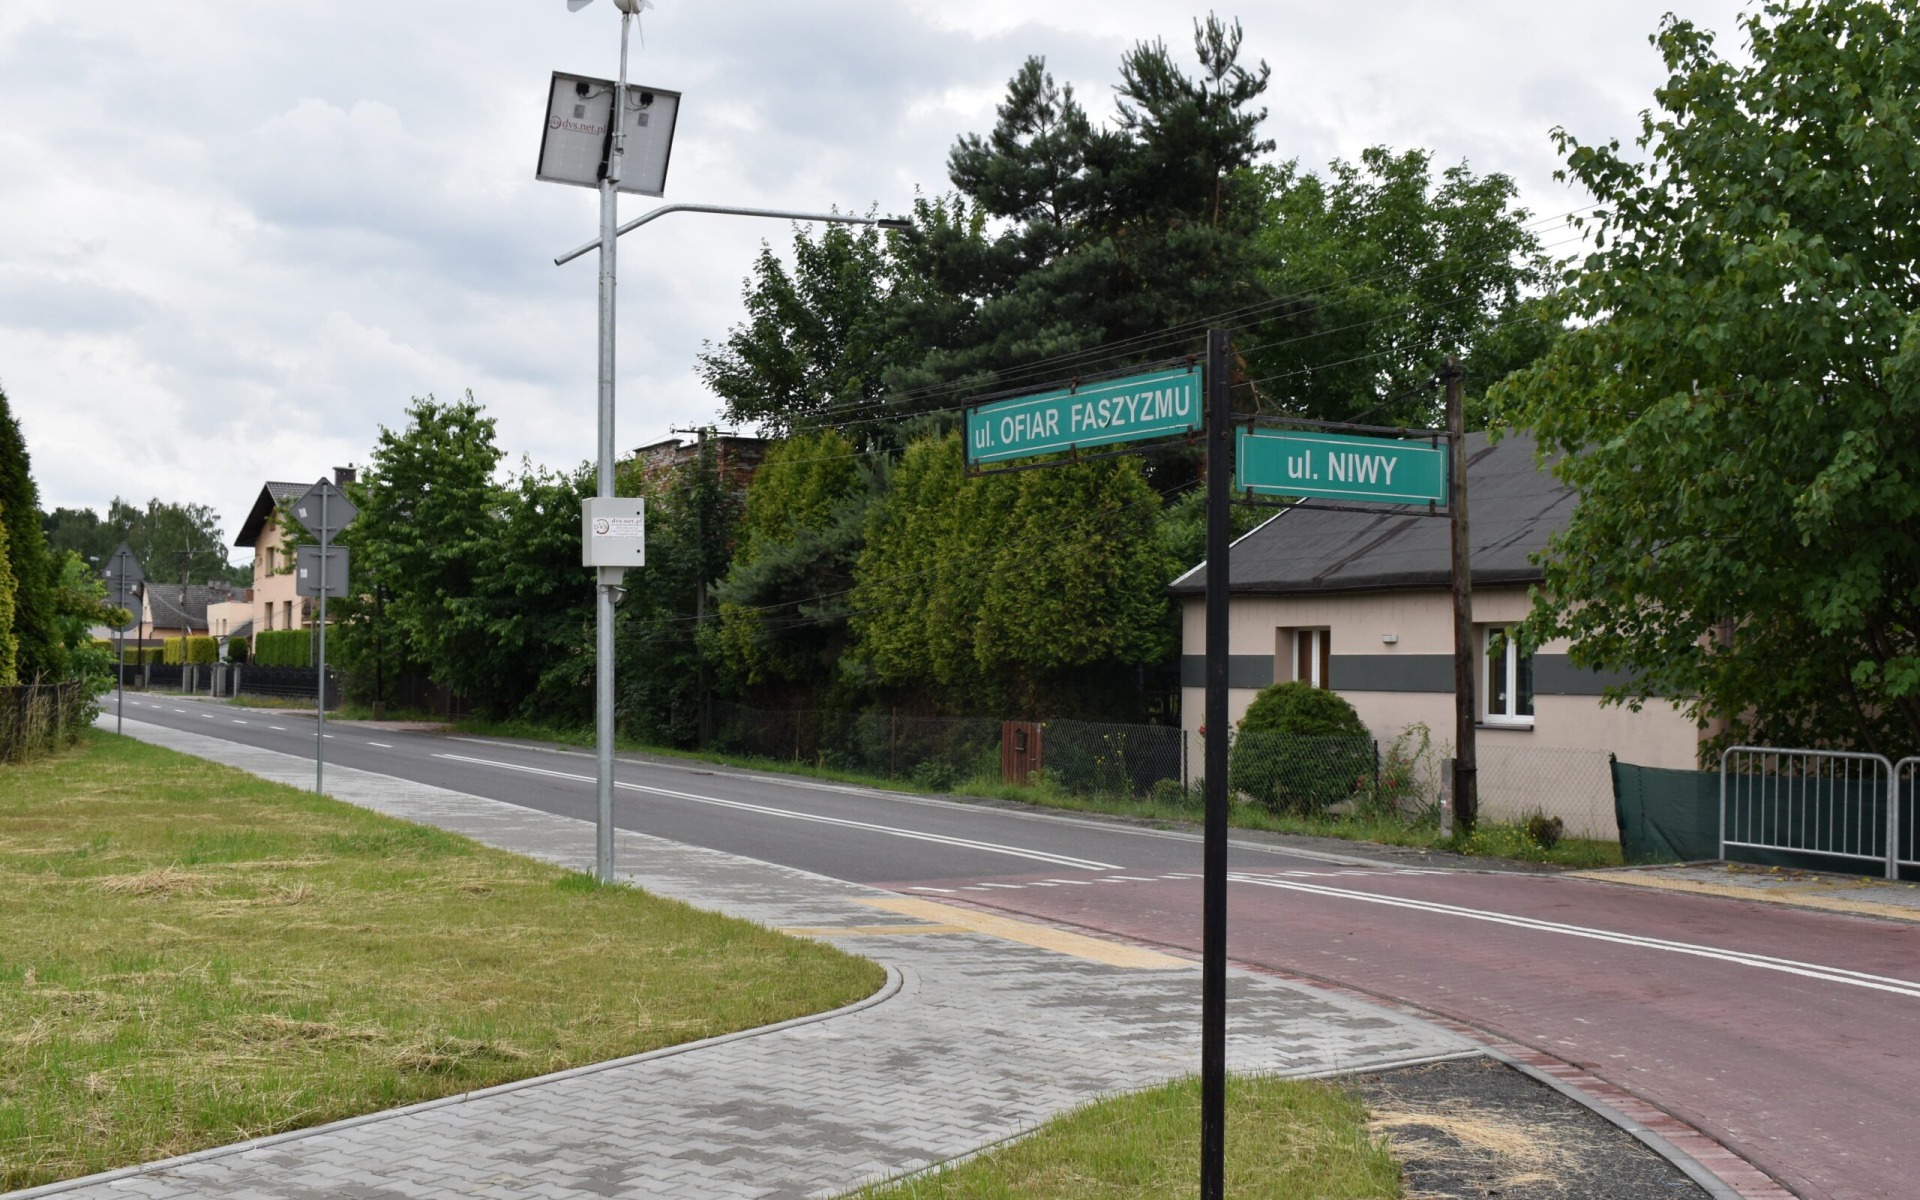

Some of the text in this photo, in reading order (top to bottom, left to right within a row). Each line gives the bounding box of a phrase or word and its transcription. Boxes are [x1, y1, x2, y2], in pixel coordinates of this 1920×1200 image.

[562, 118, 607, 136] dvs.net.pl
[975, 385, 1190, 449] ul. OFIAR FASZYZMU
[1288, 449, 1398, 486] ul. NIWY
